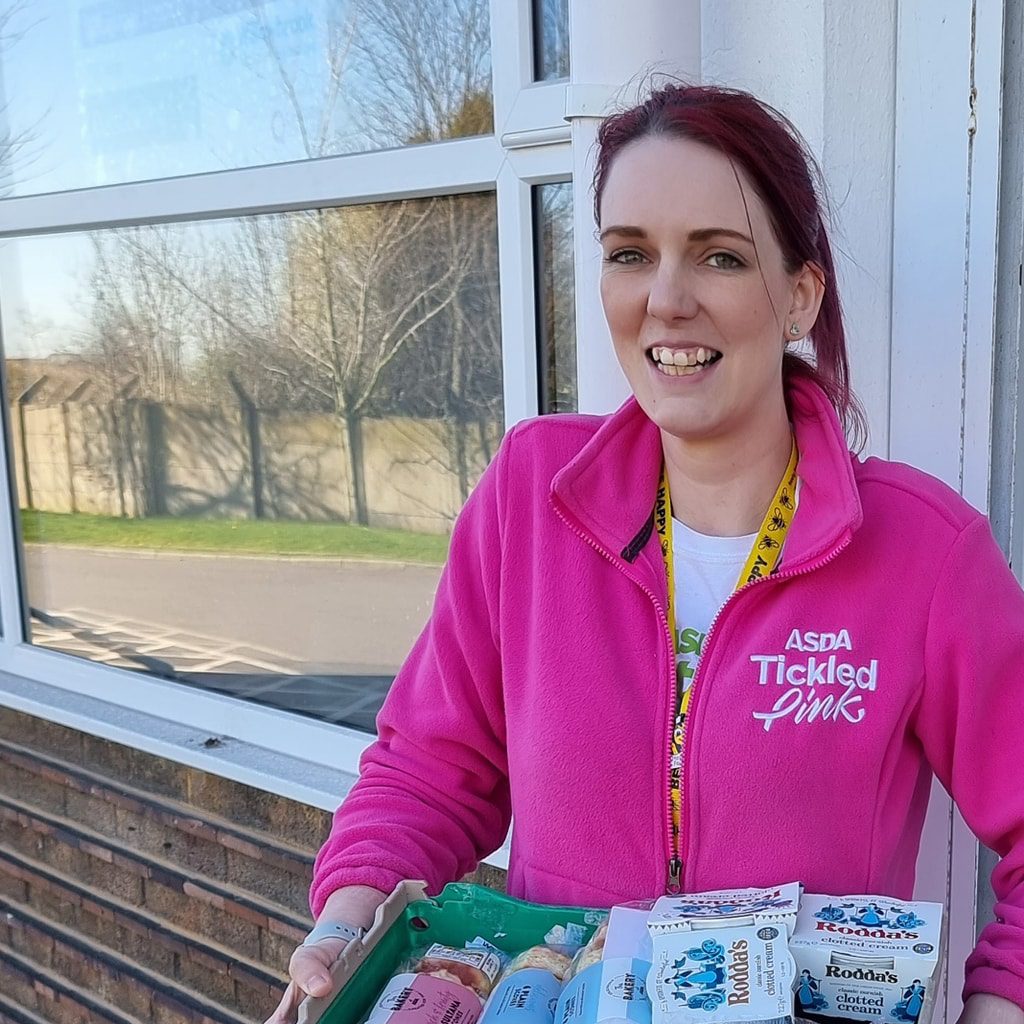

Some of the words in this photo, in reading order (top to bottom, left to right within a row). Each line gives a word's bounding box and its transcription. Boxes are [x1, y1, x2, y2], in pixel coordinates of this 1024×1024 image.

[656, 488, 666, 535] HAPPY
[785, 628, 852, 652] ASDA
[750, 655, 878, 691] Tickled
[752, 680, 865, 731] Pink
[815, 921, 919, 940] Rodda's
[764, 942, 774, 968] cream
[821, 937, 865, 948] clotted
[868, 942, 909, 951] cream
[727, 939, 749, 1006] Rodda's
[764, 968, 775, 996] clotted
[825, 965, 898, 984] Rodda's
[390, 987, 413, 1011] BAKERY
[623, 973, 636, 1001] BAKERY
[836, 994, 884, 1007] clotted
[838, 1004, 881, 1015] cream
